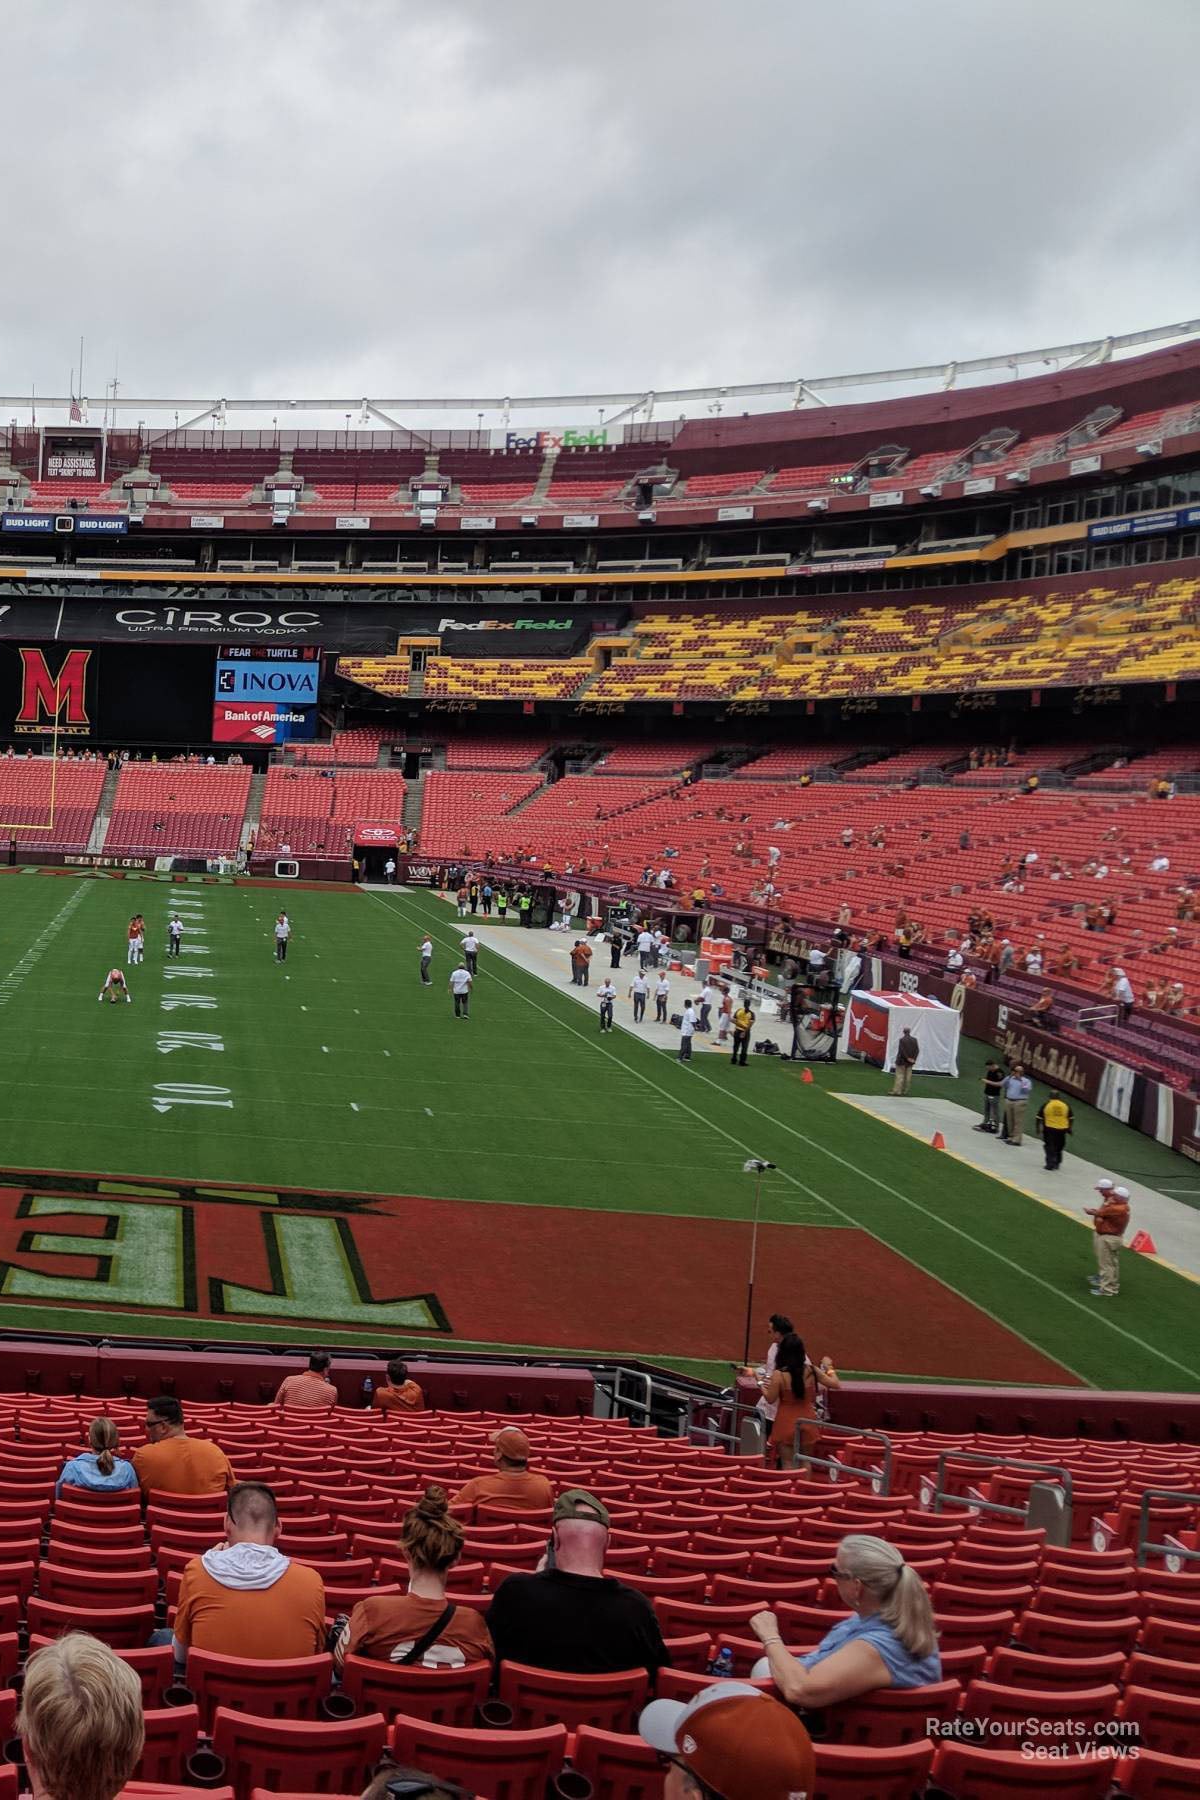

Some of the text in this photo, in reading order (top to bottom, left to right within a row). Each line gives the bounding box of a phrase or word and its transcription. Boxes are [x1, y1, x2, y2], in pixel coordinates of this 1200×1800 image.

[506, 429, 607, 449] FedExField
[49, 458, 96, 469] NEED ASSISTANCE
[48, 468, 58, 477] TEXT
[6, 519, 50, 528] BUD LIGHT
[79, 521, 124, 529] BUD LIGHT
[115, 607, 321, 627] CÎROC
[438, 619, 573, 633] FedExField
[223, 648, 298, 658] #FEARTHETURTLE
[15, 648, 92, 723] M
[243, 673, 314, 691] INOVA
[224, 710, 305, 722] Bank of America
[156, 1031, 225, 1051] 20
[152, 1082, 234, 1109] 10
